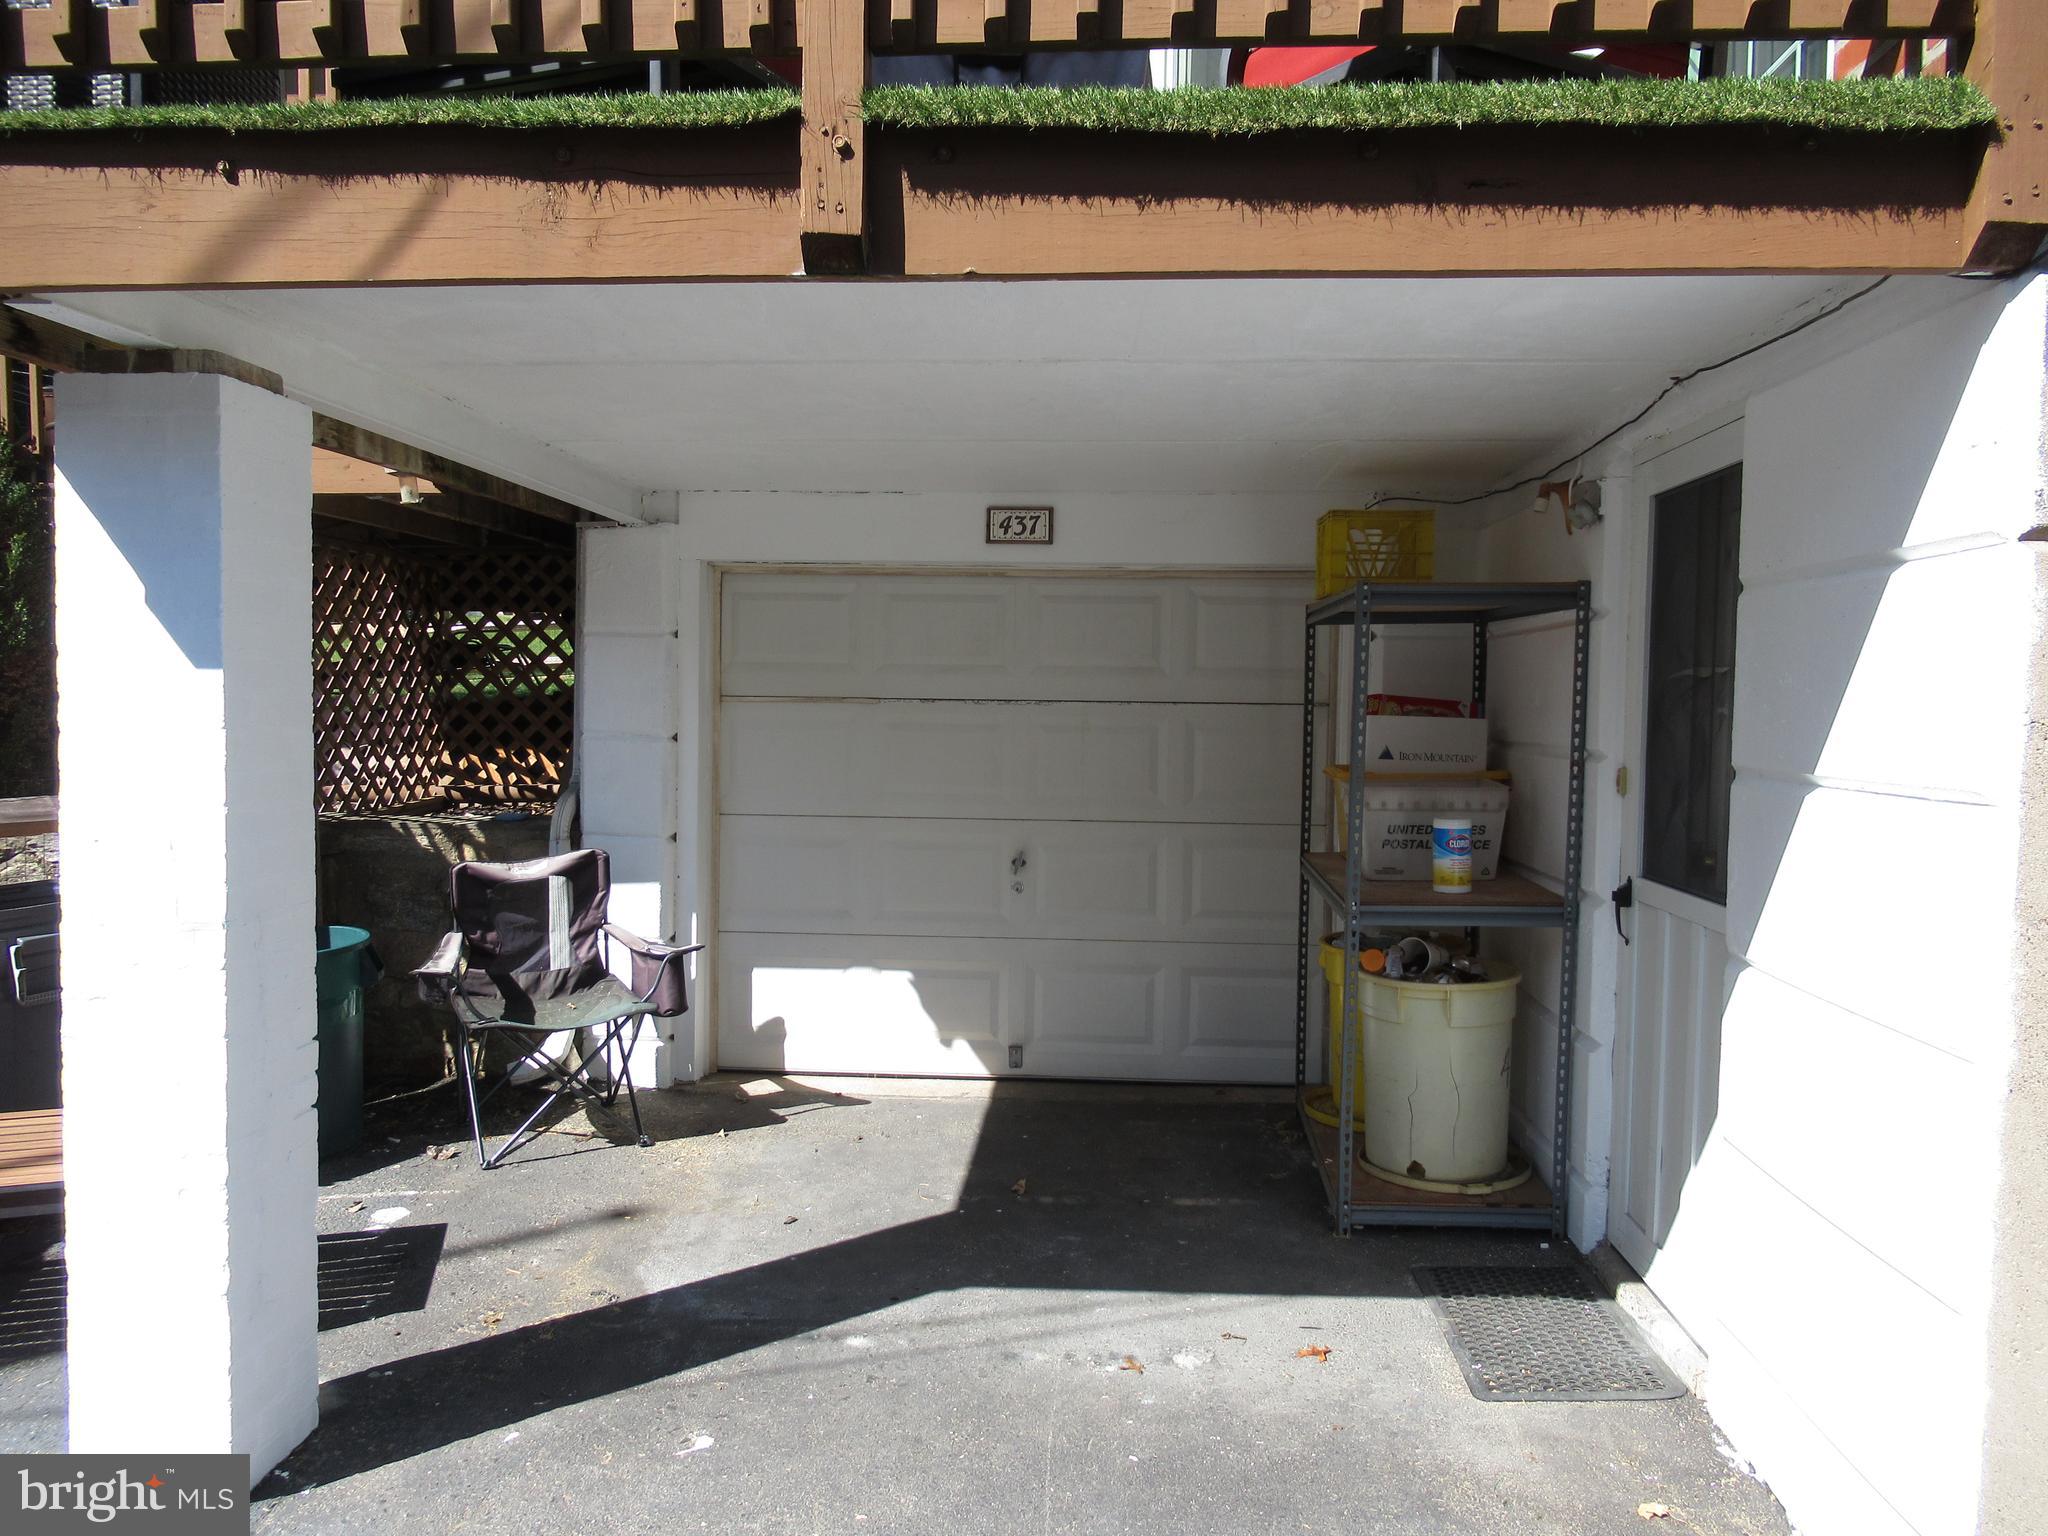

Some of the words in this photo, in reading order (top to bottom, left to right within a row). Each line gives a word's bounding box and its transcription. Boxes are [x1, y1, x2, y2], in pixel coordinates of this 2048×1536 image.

[998, 515, 1041, 536] 437
[1399, 751, 1422, 761] IRON
[1423, 752, 1475, 764] MOUNTAIN
[1387, 824, 1434, 835] UNITED
[1382, 839, 1433, 849] POSTAL
